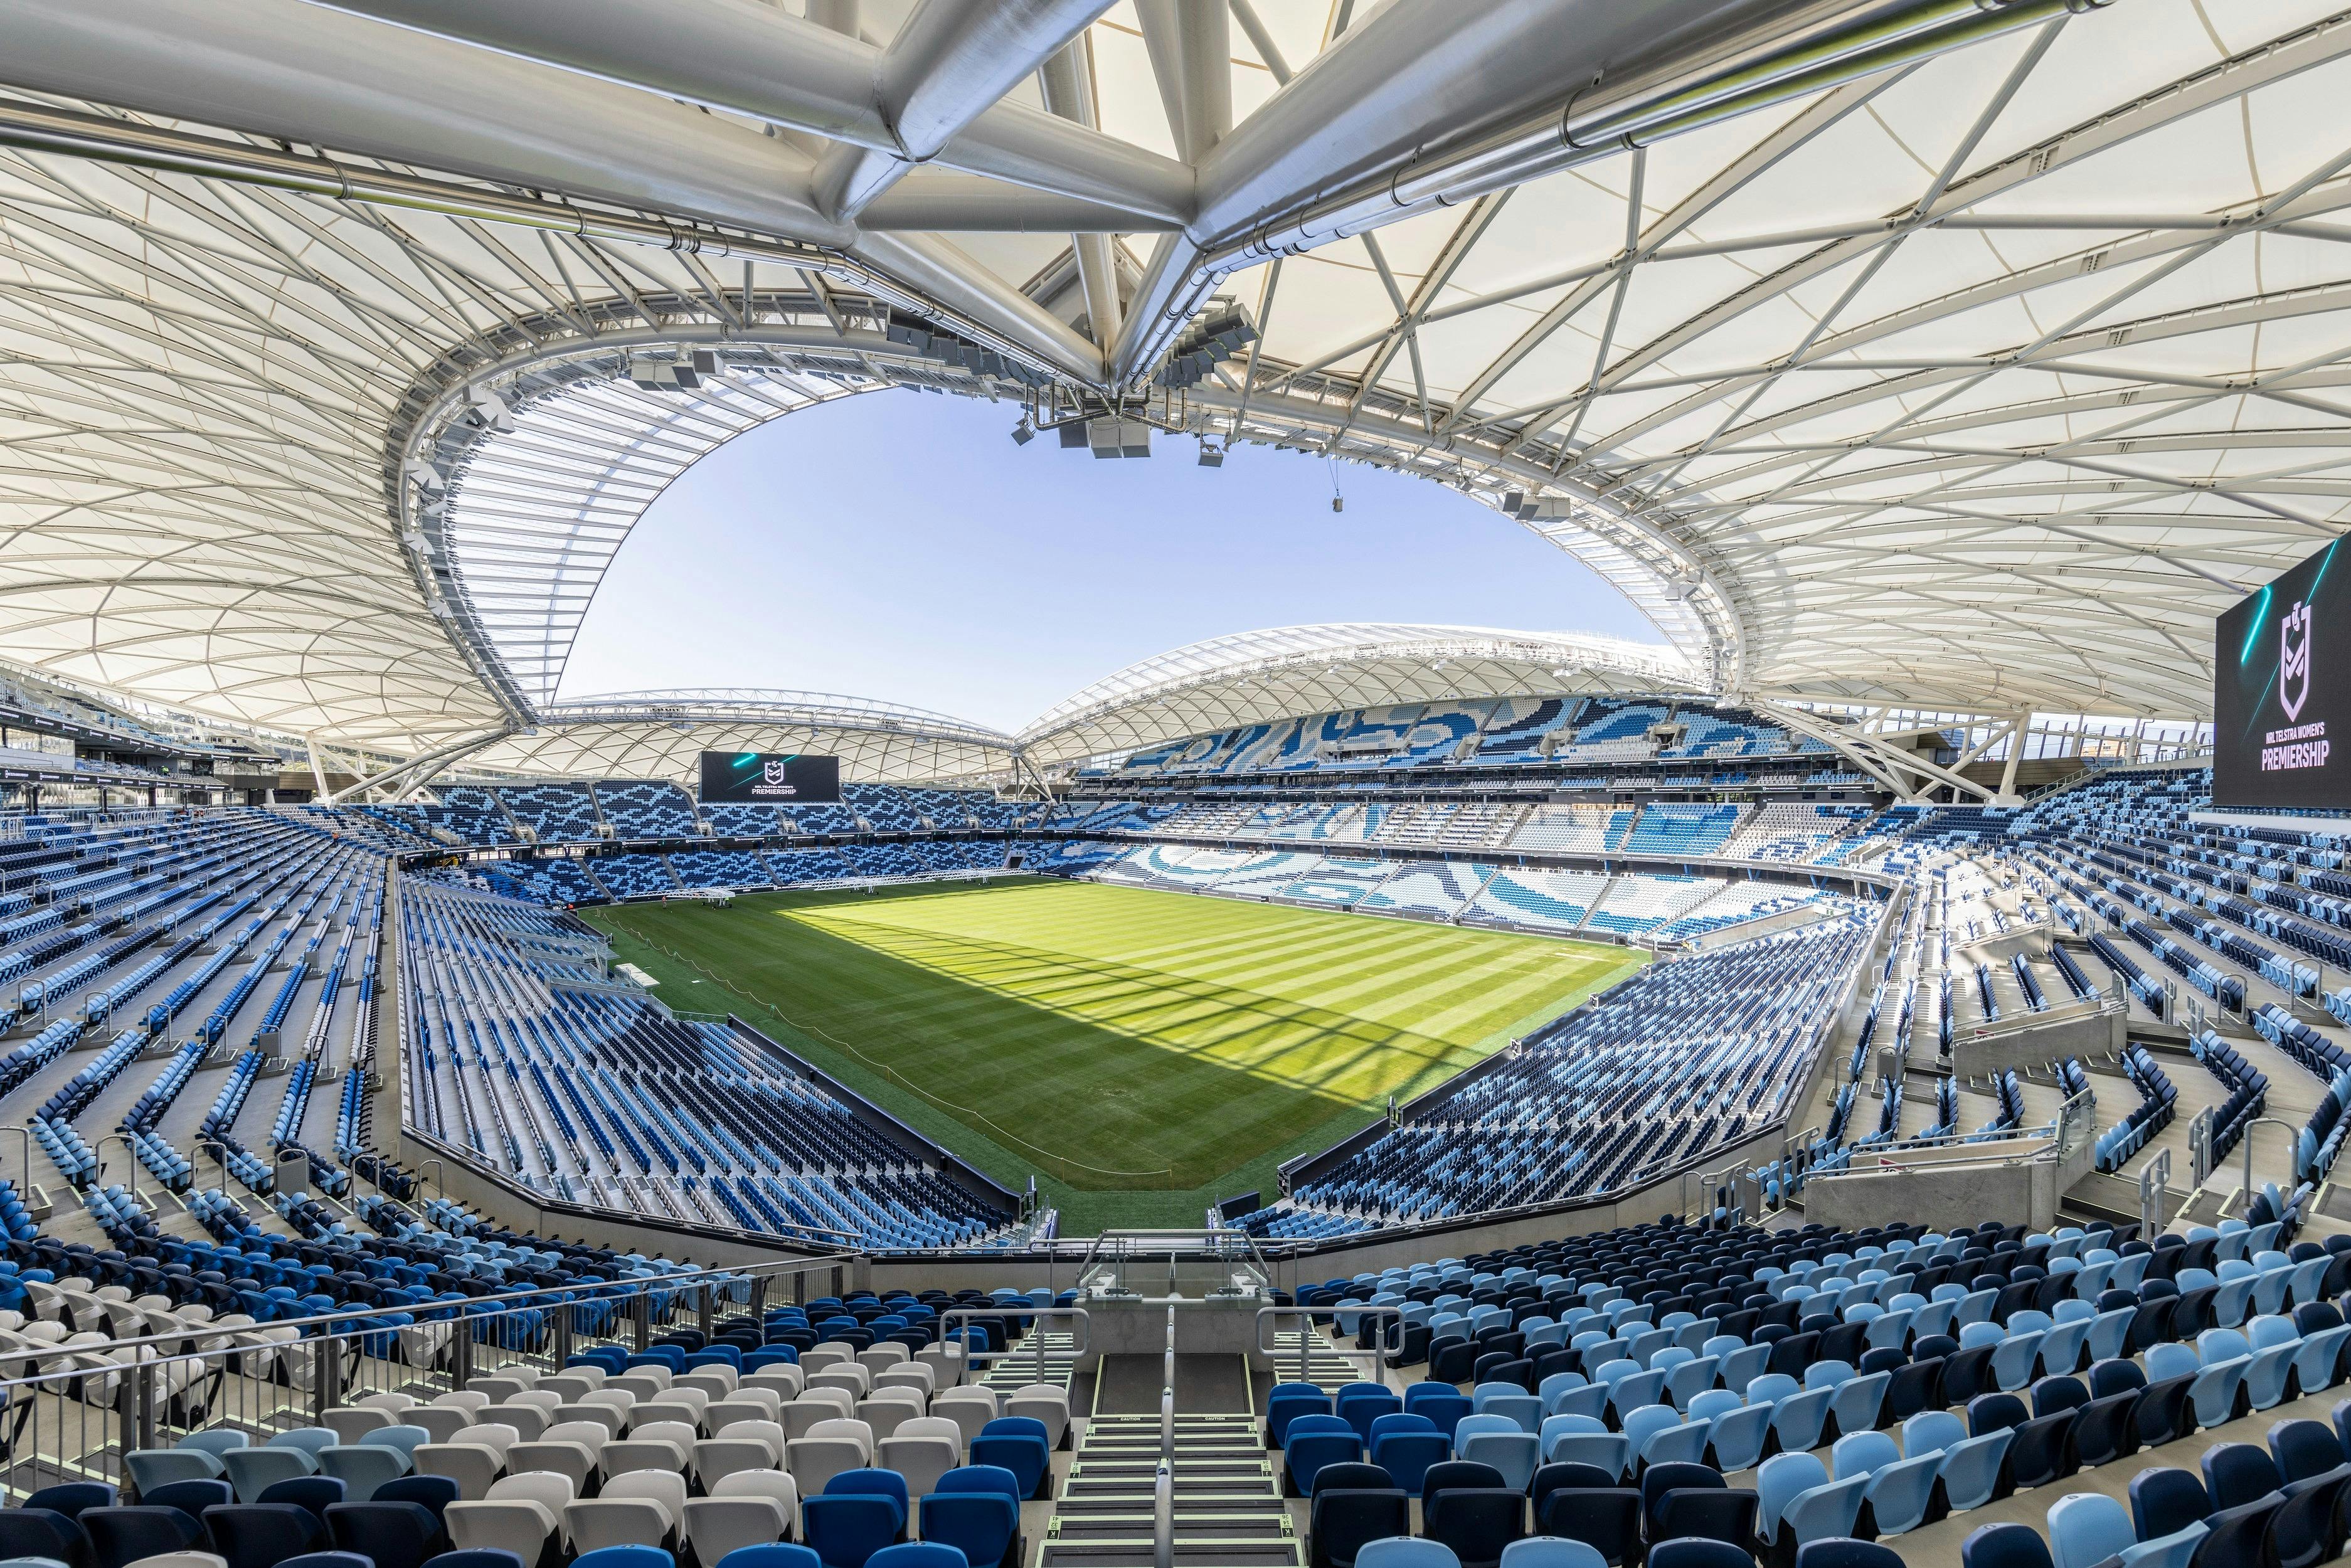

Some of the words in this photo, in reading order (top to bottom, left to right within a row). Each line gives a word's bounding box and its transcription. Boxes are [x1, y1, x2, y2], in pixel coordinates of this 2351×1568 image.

[2266, 731, 2276, 744] NRL
[2276, 727, 2298, 743] TELSTRA
[2298, 721, 2325, 738] WOMEN'S
[2262, 740, 2329, 771] PREMIERSHIP
